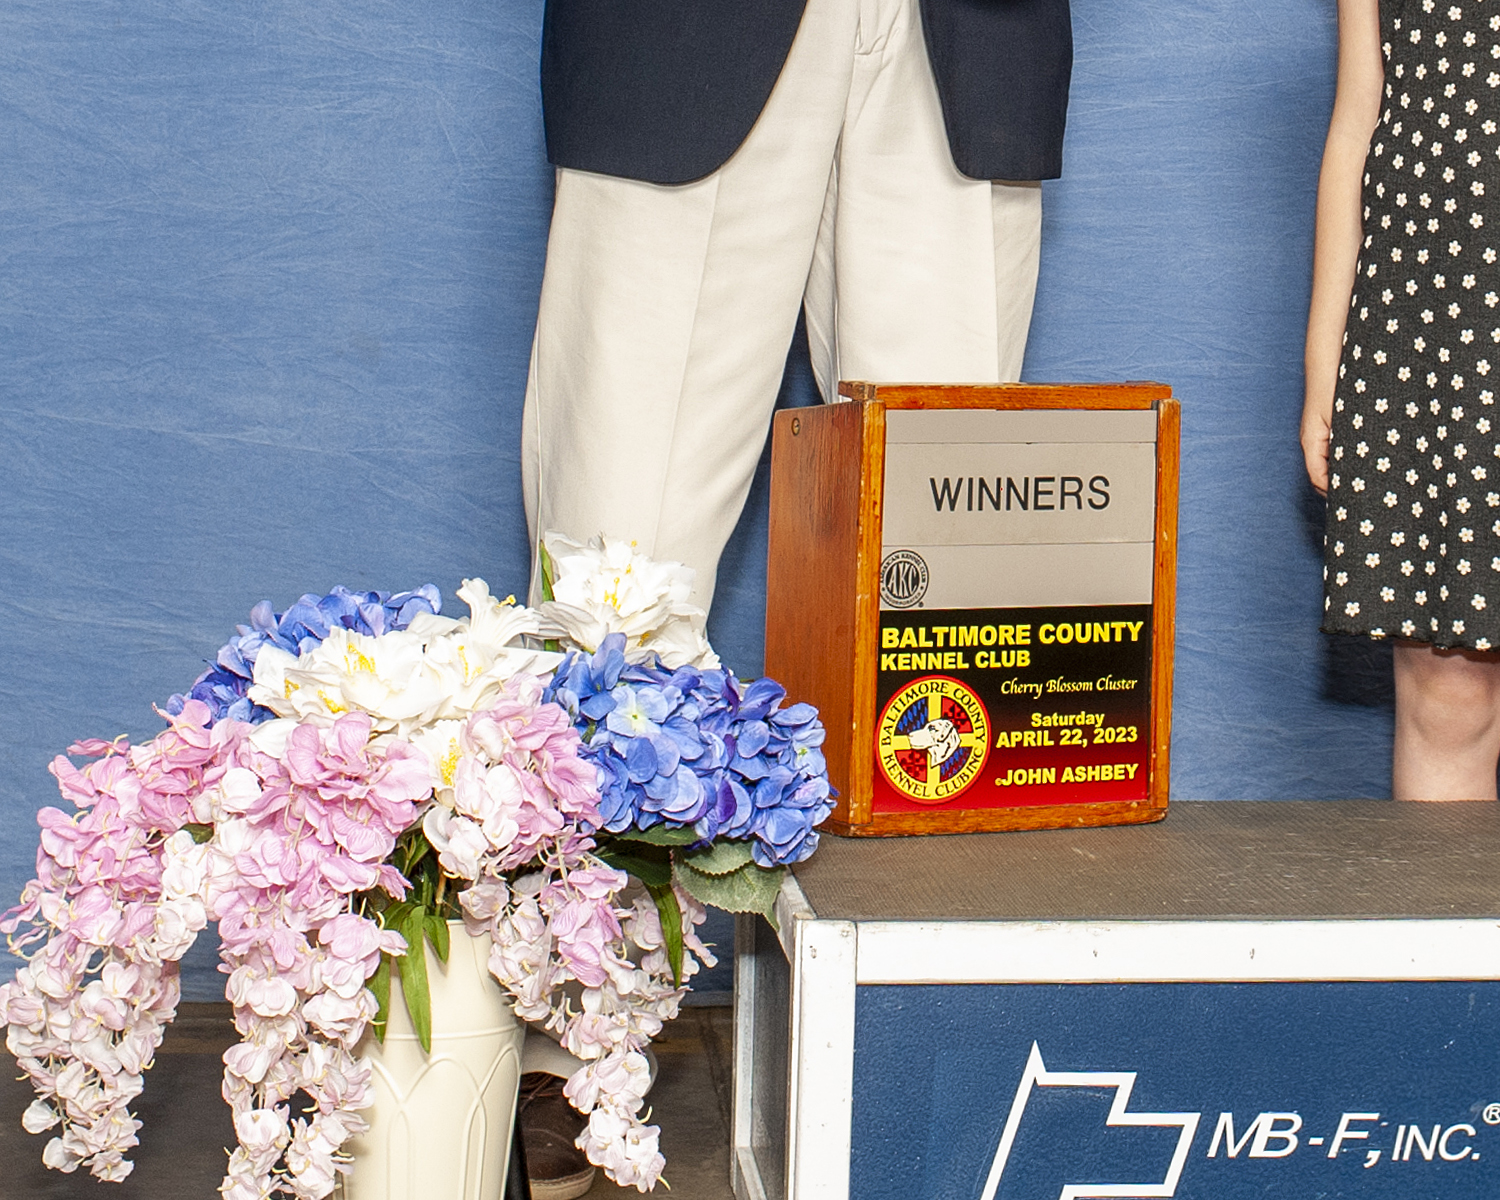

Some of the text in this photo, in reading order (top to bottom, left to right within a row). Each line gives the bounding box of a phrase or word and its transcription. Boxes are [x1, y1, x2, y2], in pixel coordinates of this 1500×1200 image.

[929, 475, 1110, 511] WINNERS
[887, 562, 918, 598] AKC
[881, 621, 1144, 648] BALTIMORE COUNTY
[881, 650, 1031, 670] KENNEL CLUB
[1001, 674, 1138, 699] Cherry Blossom Cluster
[882, 682, 985, 746] BALTIMORE COUNTY
[1031, 711, 1105, 727] Saturday
[996, 726, 1138, 748] APRIL 22, 2023
[884, 747, 984, 797] KENNEL CLUB INC
[1061, 763, 1139, 783] ASHBEY
